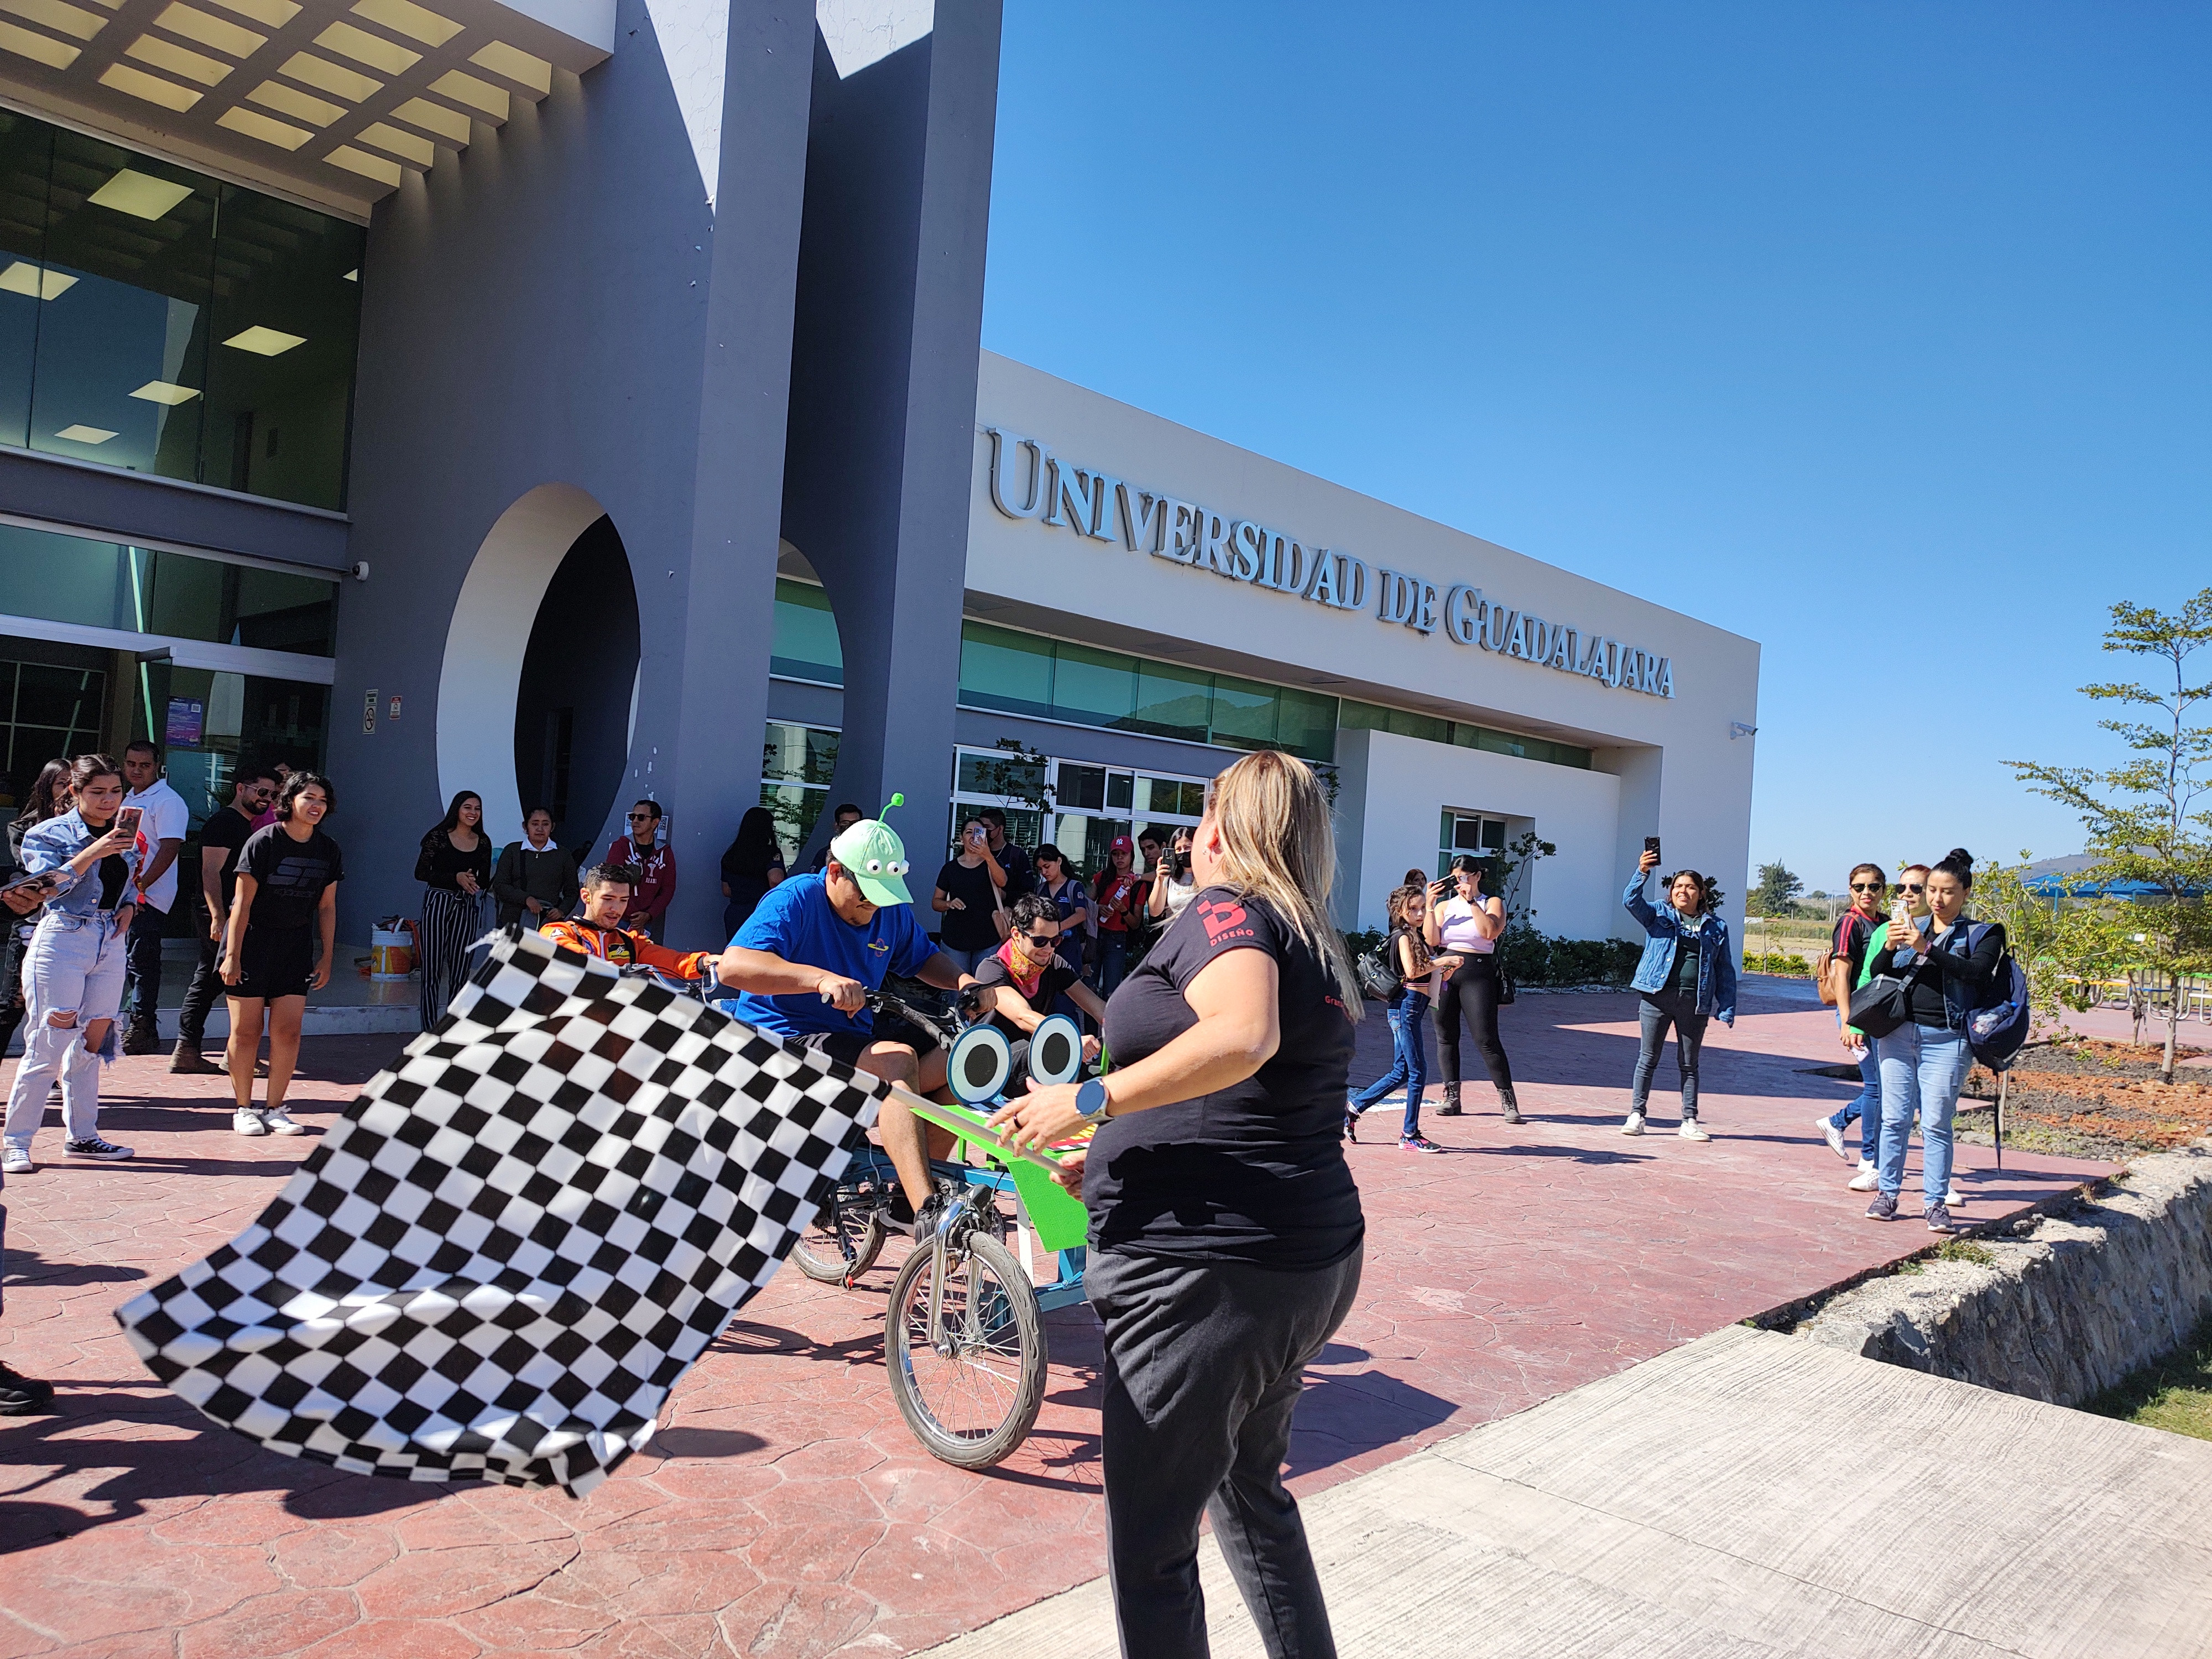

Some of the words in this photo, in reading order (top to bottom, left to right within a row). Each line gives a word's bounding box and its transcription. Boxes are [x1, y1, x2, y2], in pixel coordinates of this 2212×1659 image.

[988, 427, 1371, 611] UNIVERSIDAD
[1377, 569, 1437, 633] DE
[1446, 585, 1676, 698] GUADALAJARA
[1209, 928, 1255, 947] DISEÑO
